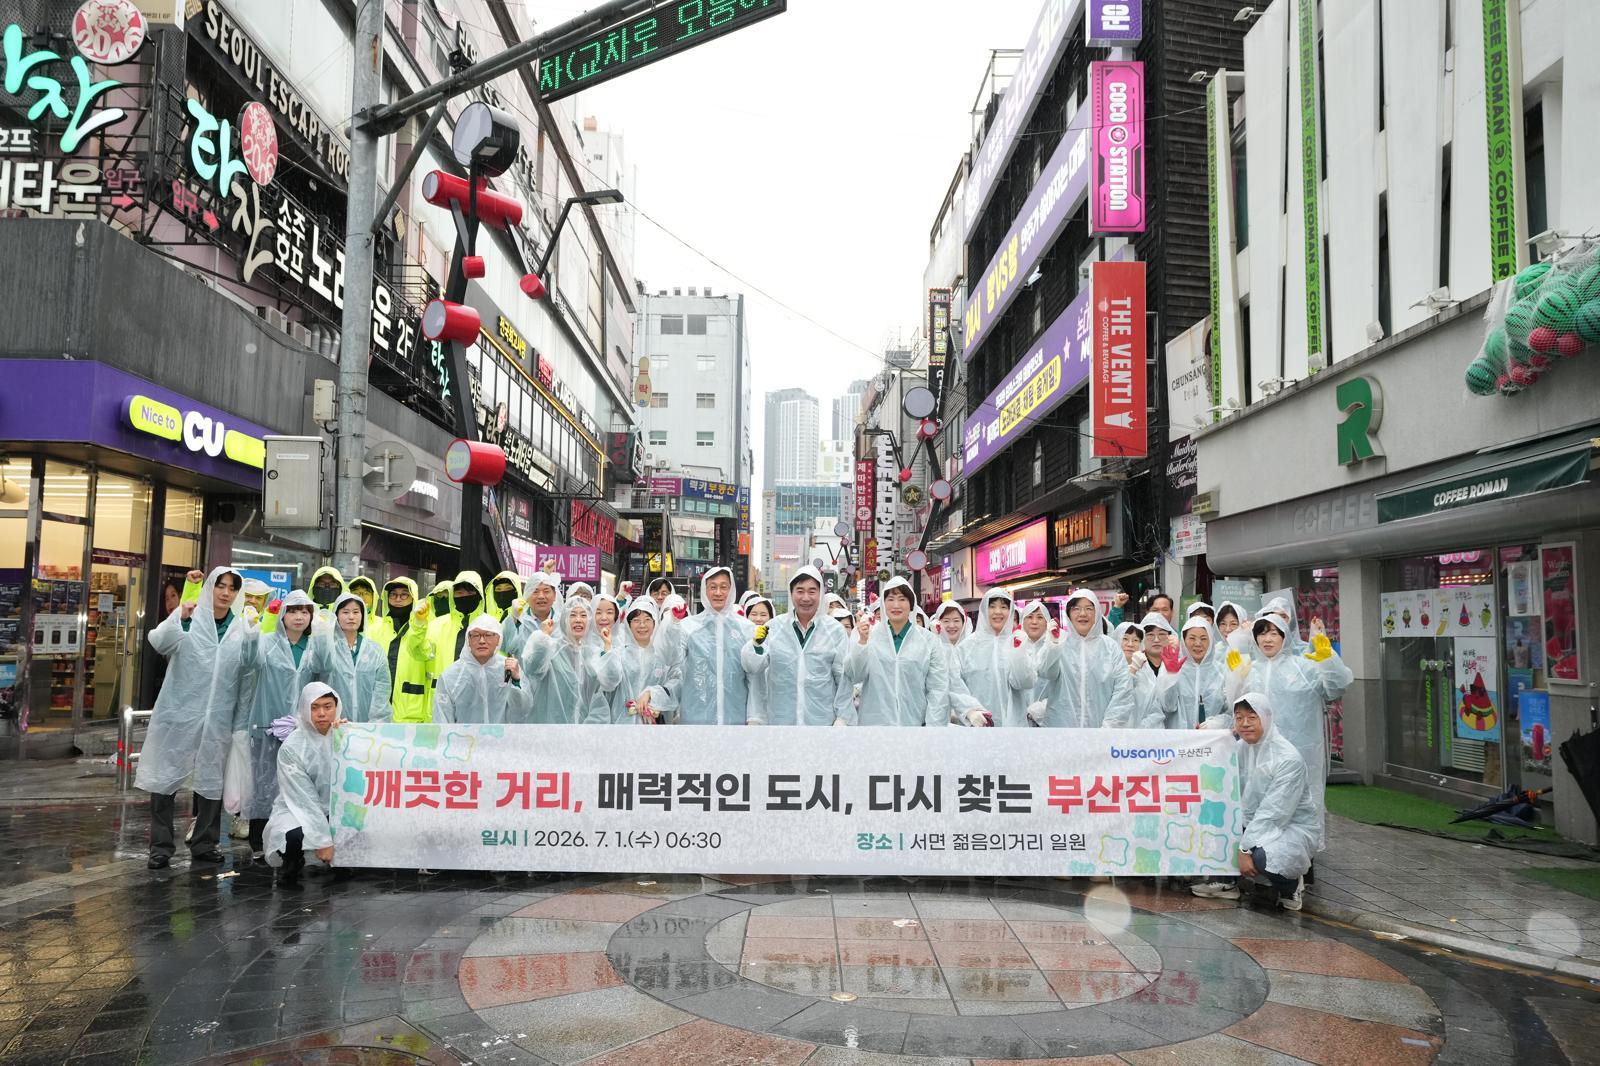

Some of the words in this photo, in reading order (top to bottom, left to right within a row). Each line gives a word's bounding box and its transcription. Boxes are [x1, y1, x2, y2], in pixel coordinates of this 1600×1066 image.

[205, 0, 264, 92] SEOUL
[269, 69, 324, 156] ESCAPE
[1301, 51, 1313, 106] ROMAN
[1490, 54, 1506, 136] ROMAN
[1109, 82, 1127, 122] COCO
[105, 168, 140, 191] 입구
[1109, 146, 1128, 211] STATION
[1305, 135, 1316, 202] COFFEE
[172, 179, 199, 219] 입구
[277, 199, 306, 236] 소주
[1494, 170, 1510, 259] COFFEE
[1306, 204, 1318, 264] ROMAN
[275, 233, 303, 284] 호프
[1111, 296, 1132, 336] THE
[397, 318, 414, 358] 2F
[1111, 343, 1132, 403] VENTI
[1171, 363, 1207, 391] CHUNSANG
[141, 405, 164, 427] Nice
[165, 413, 176, 431] to
[183, 410, 225, 457] CU
[1434, 489, 1469, 507] COFFEE
[1469, 478, 1509, 499] ROMAN
[1293, 495, 1371, 535] COFFEE
[569, 554, 596, 578] 패션몰
[1005, 538, 1027, 569] STATION
[827, 578, 834, 588] S
[1110, 745, 1176, 764] busanjin
[1177, 747, 1213, 758] 부산진구
[363, 770, 482, 810] 깨끗한
[495, 770, 583, 813] 거리,
[598, 772, 751, 812] 매력적인
[765, 773, 853, 815] 도시,
[868, 774, 942, 813] 다시
[956, 775, 1033, 814] 찾는
[1047, 775, 1202, 814] 부산진구
[480, 829, 518, 847] 일시
[534, 830, 590, 848] 2026.
[595, 830, 609, 848] 7.
[615, 829, 660, 850] 1.(수)
[665, 830, 722, 849] 06:30
[856, 832, 894, 851] 장소
[909, 833, 946, 851] 서면
[952, 833, 1044, 852] 젊음의거리
[1050, 833, 1087, 852] 일원
